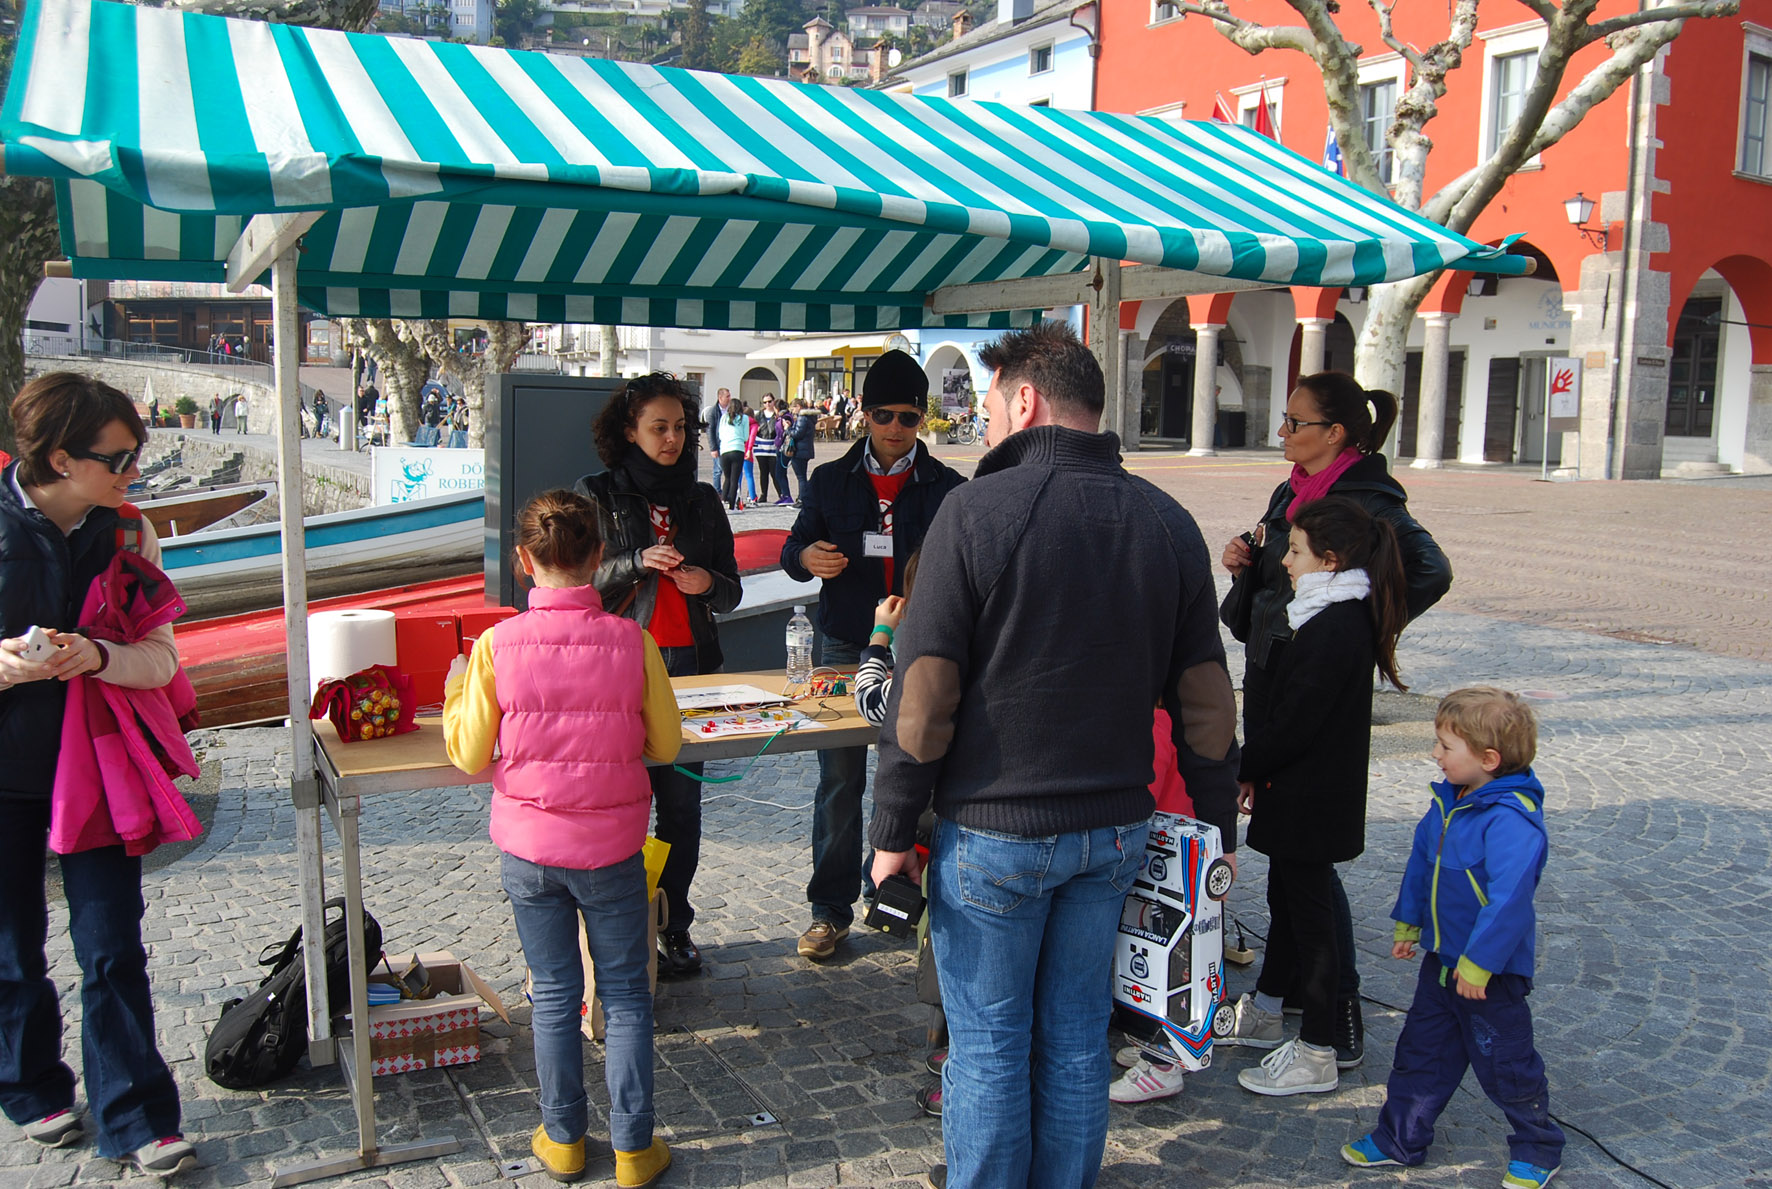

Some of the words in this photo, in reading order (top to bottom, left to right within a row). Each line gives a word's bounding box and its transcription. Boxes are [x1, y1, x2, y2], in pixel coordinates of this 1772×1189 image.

[461, 462, 485, 475] DÖ
[1150, 831, 1175, 845] MARTINI
[1120, 925, 1143, 937] MARTINI
[1143, 931, 1168, 945] LANCIA
[1208, 962, 1220, 1004] MARTINI
[1123, 985, 1151, 1002] MARTINI
